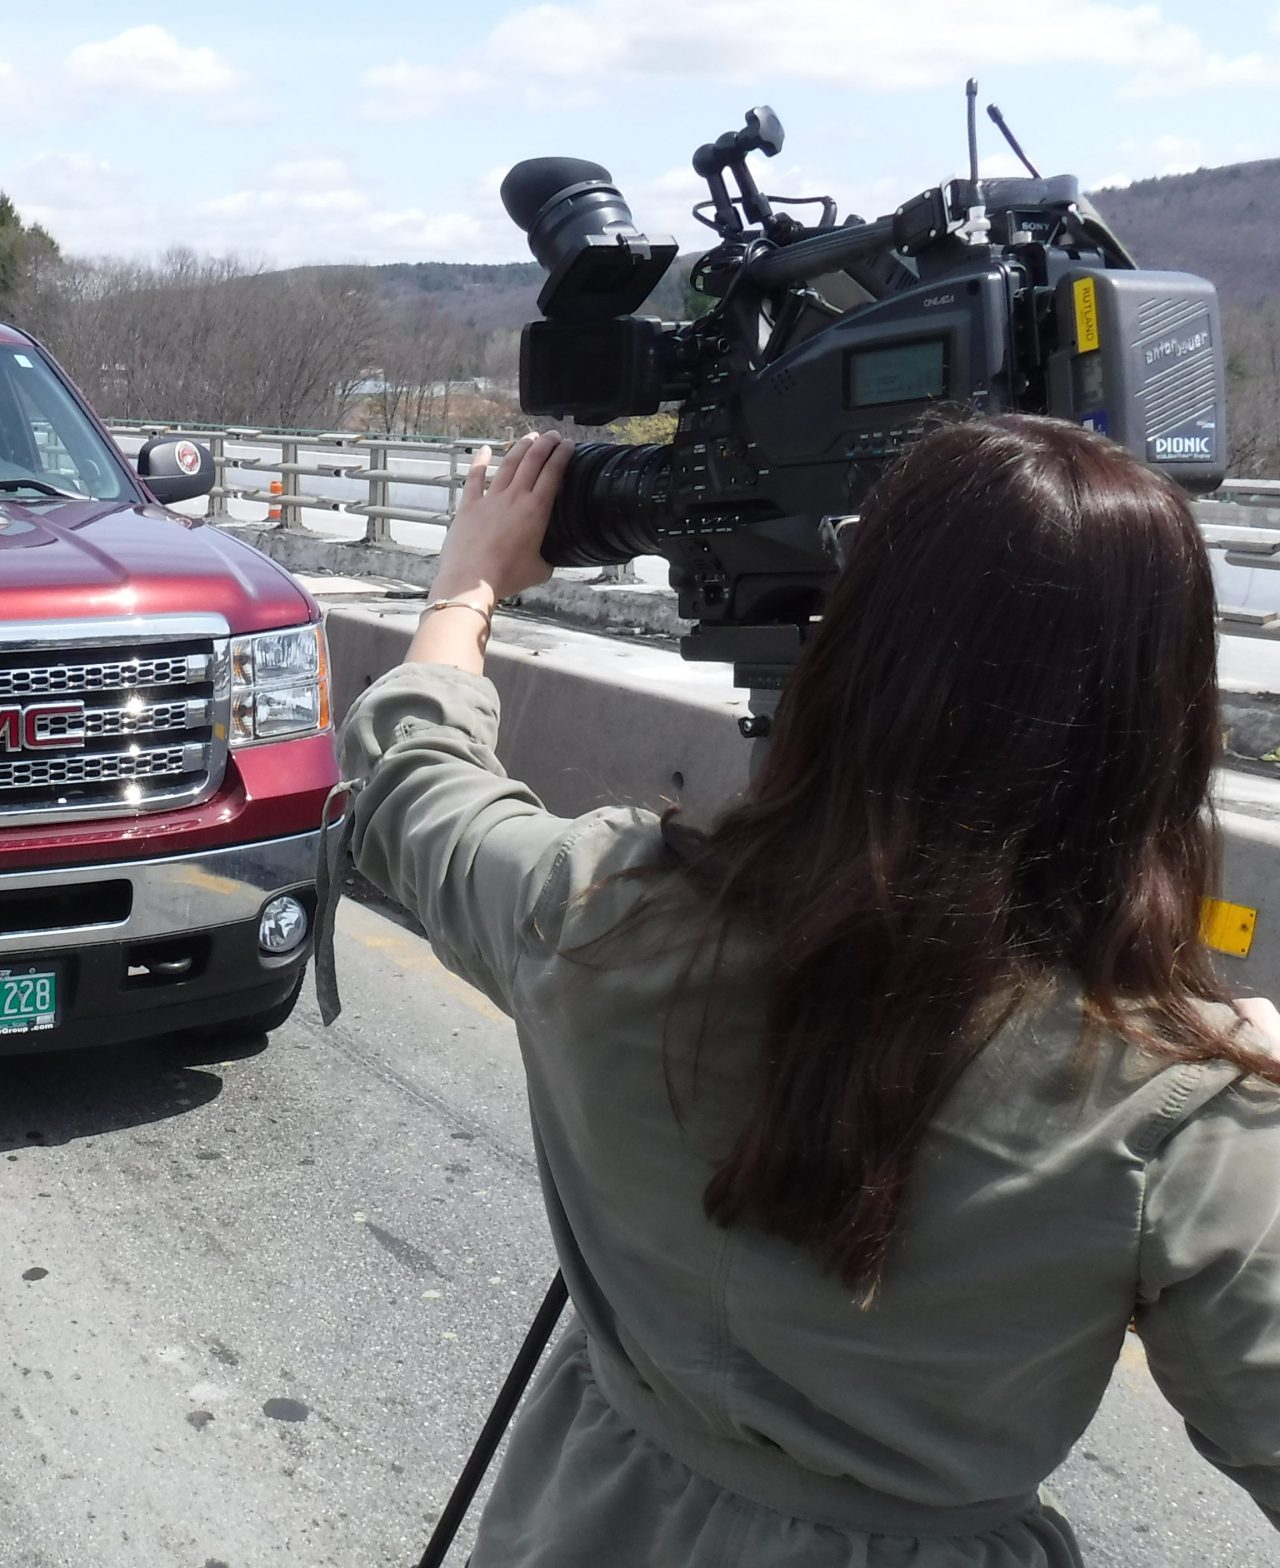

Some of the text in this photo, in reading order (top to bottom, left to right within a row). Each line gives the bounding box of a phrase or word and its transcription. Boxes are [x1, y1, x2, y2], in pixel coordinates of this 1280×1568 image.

[1021, 221, 1050, 231] SONY
[1082, 287, 1096, 342] RUTLAND
[1155, 437, 1211, 453] DIONIC
[4, 979, 50, 1014] 228
[30, 1023, 54, 1031] .com
